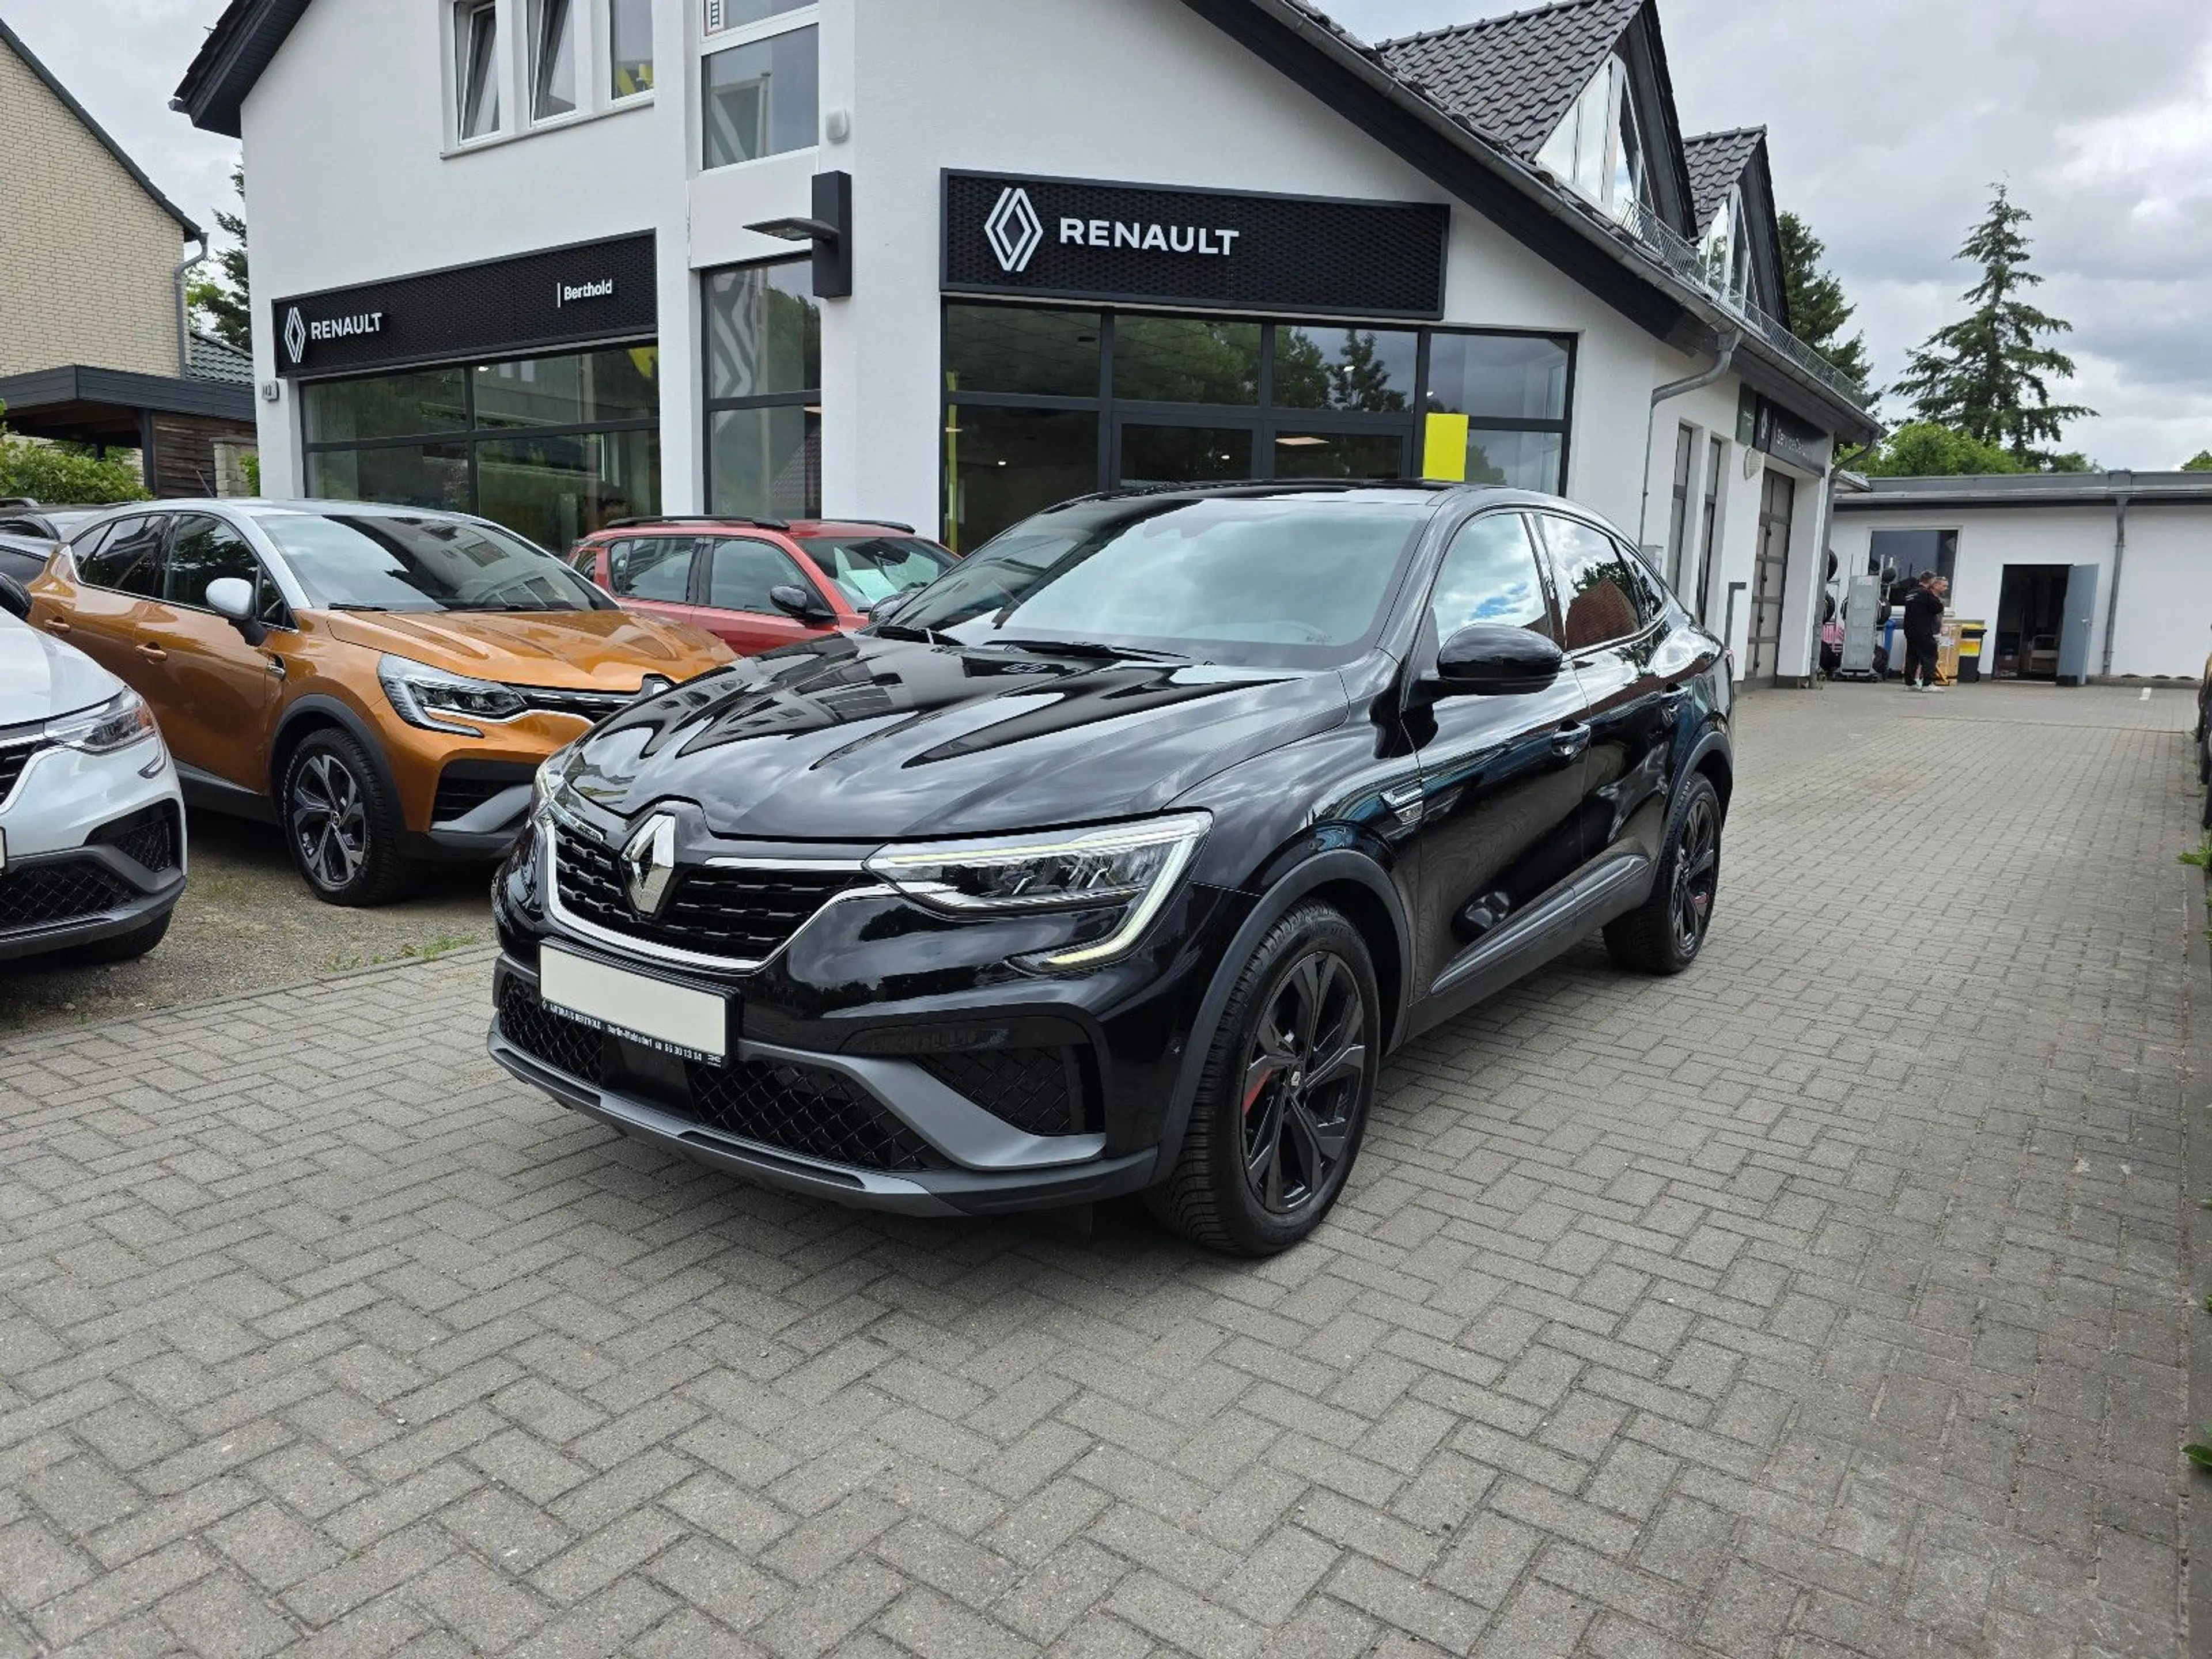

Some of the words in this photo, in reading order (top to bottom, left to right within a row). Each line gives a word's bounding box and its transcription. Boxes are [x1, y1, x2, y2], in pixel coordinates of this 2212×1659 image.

[1060, 217, 1239, 255] RENAULT
[564, 278, 612, 301] Berthold
[310, 312, 382, 340] RENAULT
